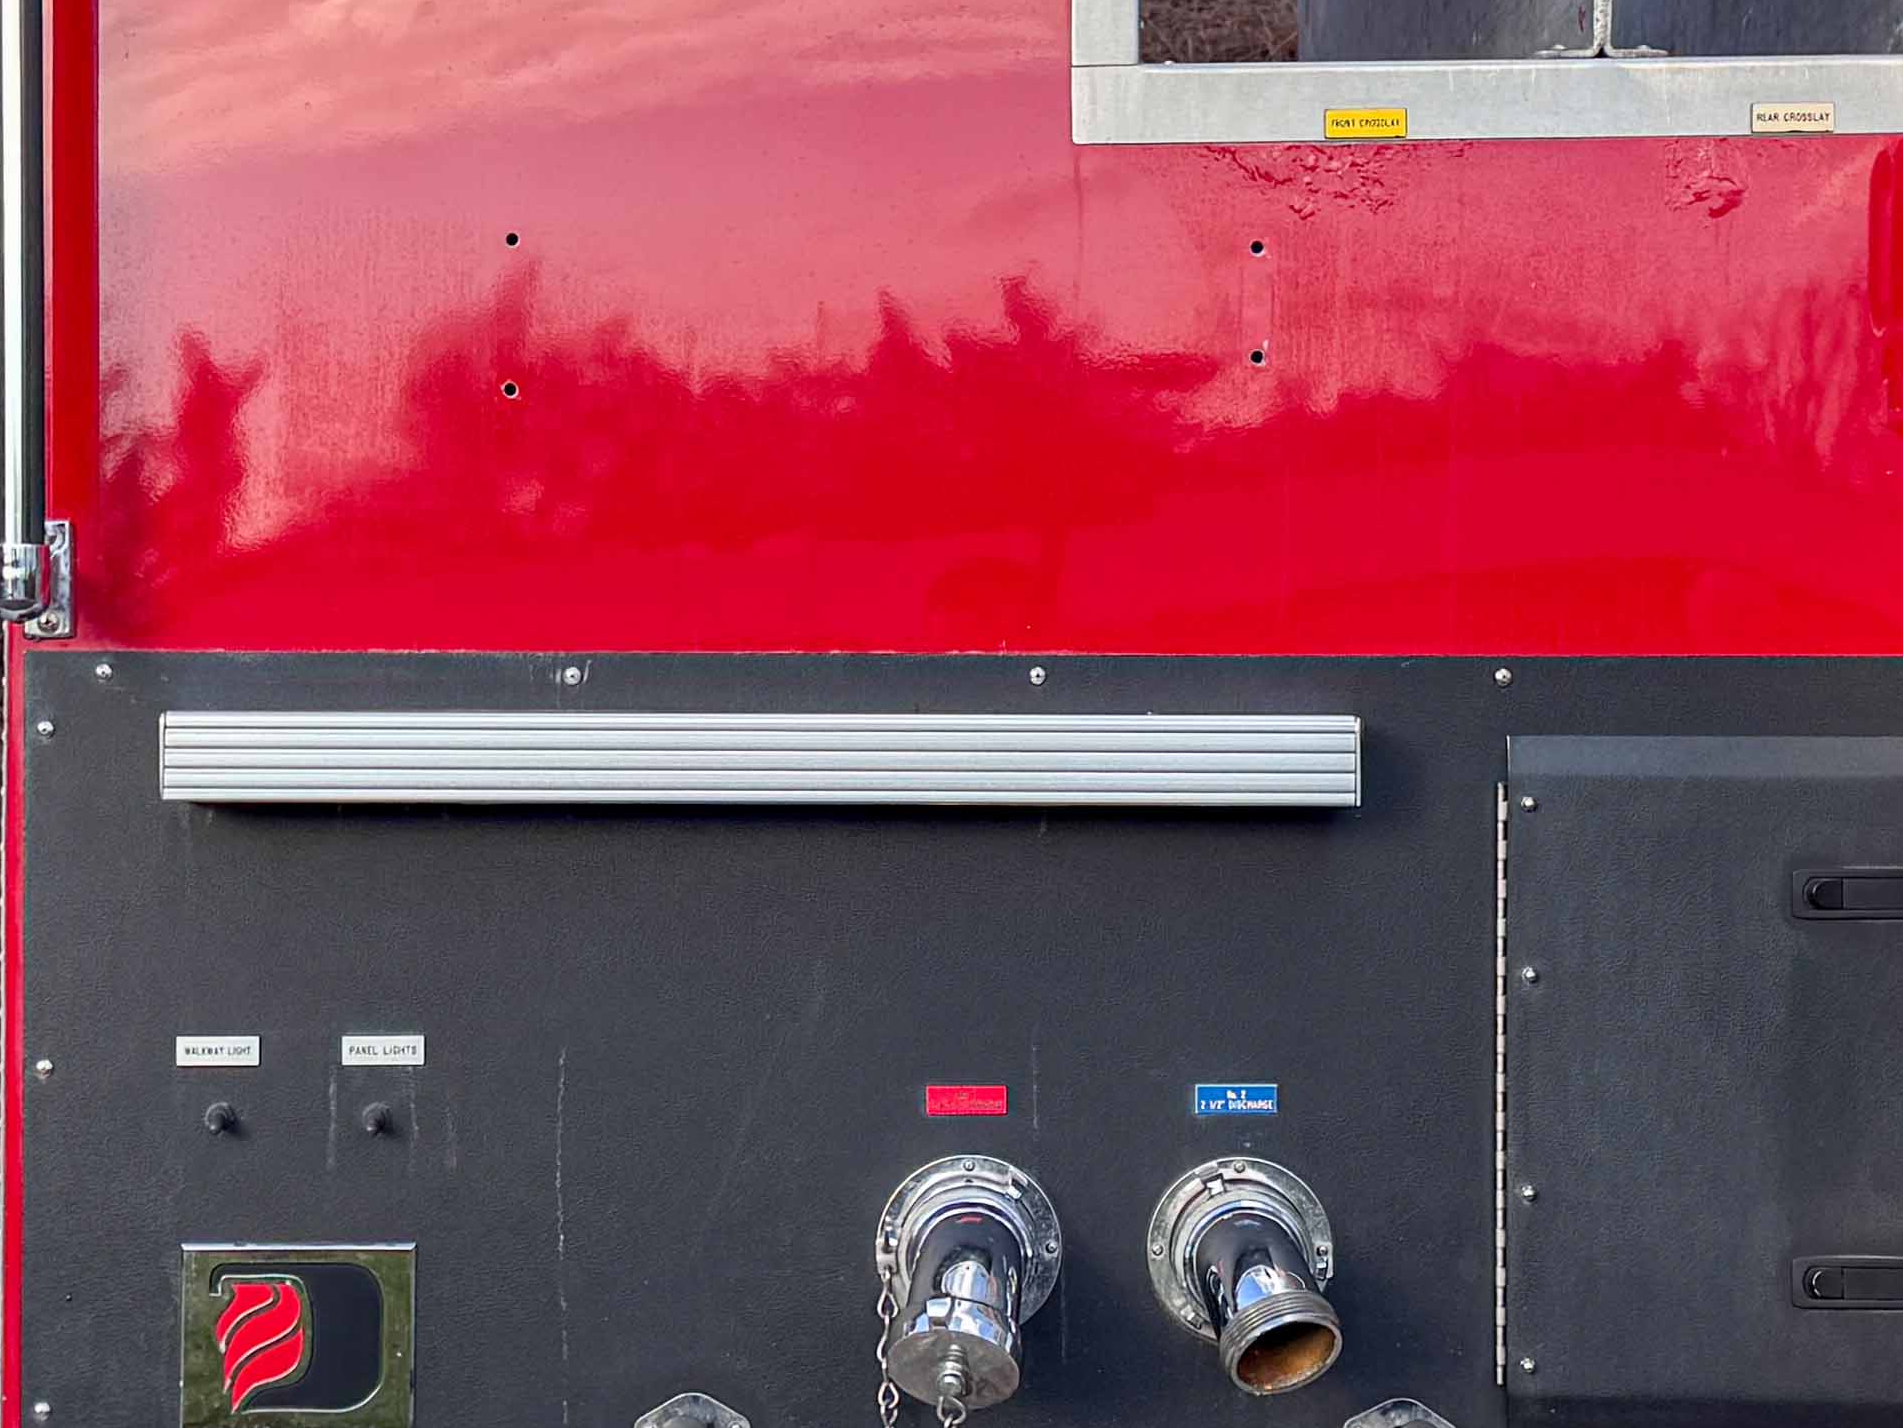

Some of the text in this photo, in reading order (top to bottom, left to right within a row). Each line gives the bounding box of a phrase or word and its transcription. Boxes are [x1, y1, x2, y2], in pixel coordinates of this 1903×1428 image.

[1756, 112, 1830, 122] REAR CROSSLAY
[184, 1046, 252, 1056] WALKWAY LIGHT
[348, 1045, 418, 1056] PANEL LIGHTS
[1228, 1099, 1275, 1110] DISCHARGE
